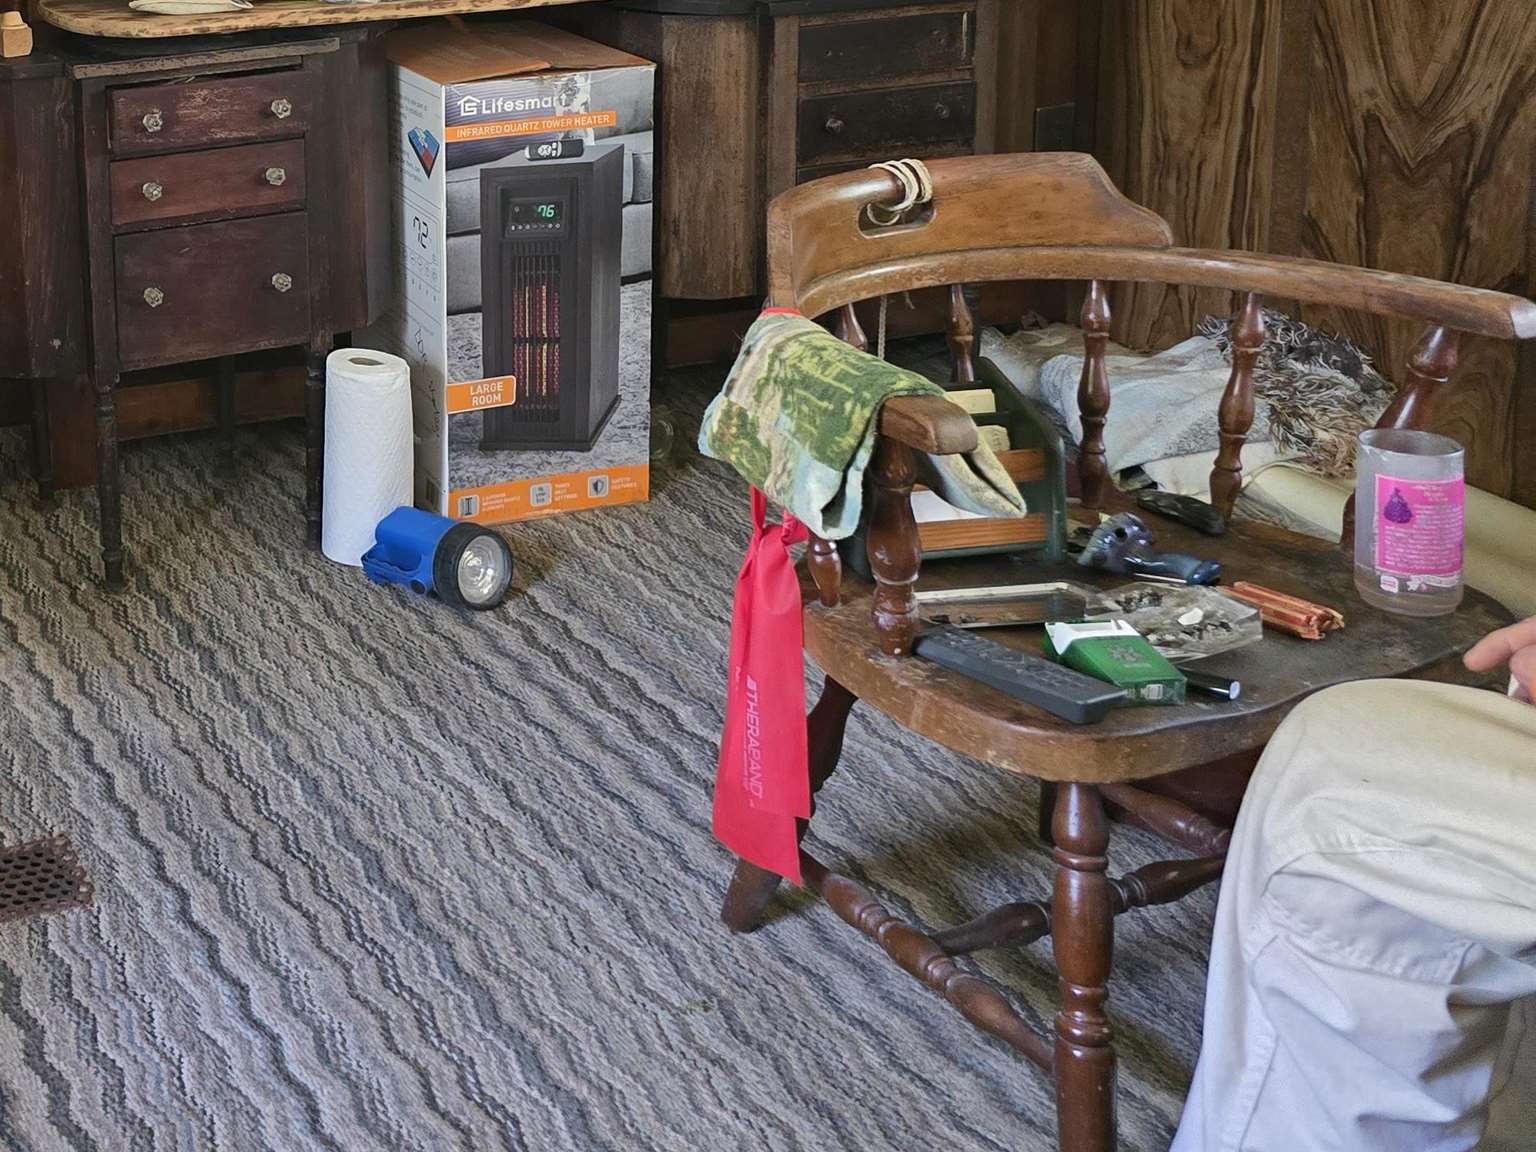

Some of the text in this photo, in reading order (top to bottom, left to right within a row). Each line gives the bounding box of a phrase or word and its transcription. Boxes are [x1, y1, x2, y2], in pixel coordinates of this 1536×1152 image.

[456, 114, 610, 138] INFRARED QUARTZ TOWER HEATER
[537, 204, 555, 218] 76
[470, 381, 504, 396] LARGE
[472, 393, 502, 407] ROOM
